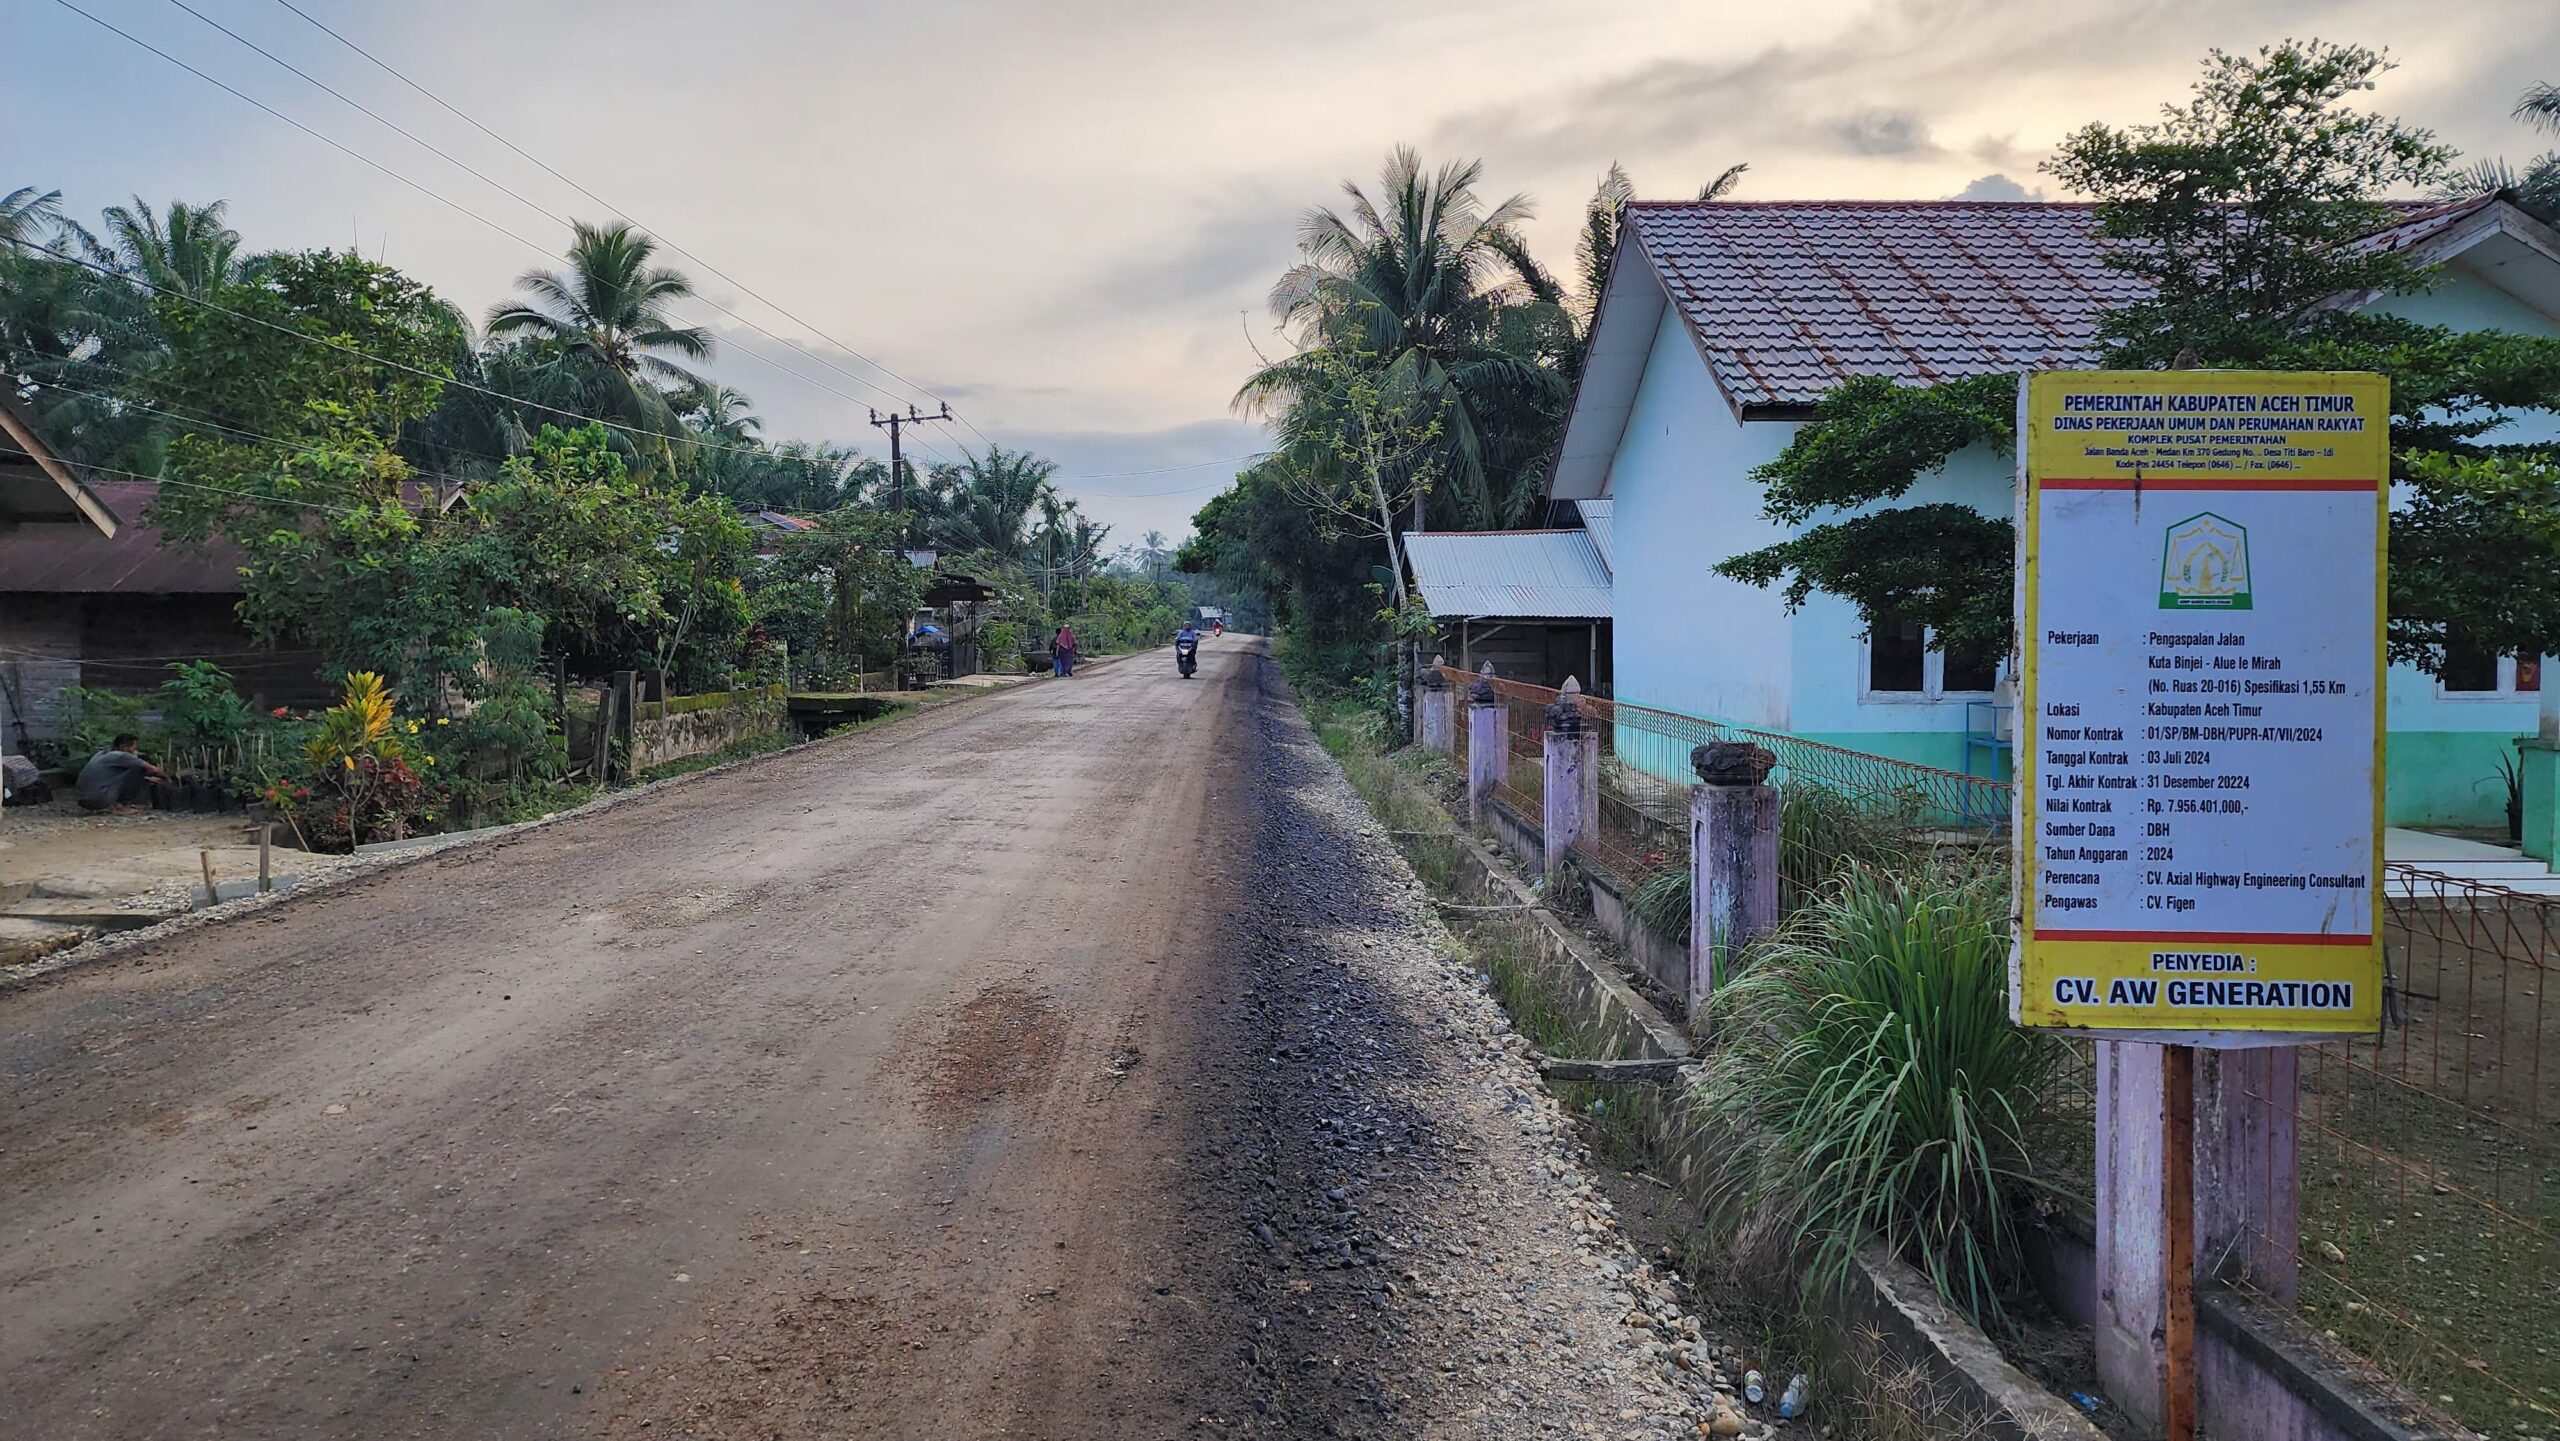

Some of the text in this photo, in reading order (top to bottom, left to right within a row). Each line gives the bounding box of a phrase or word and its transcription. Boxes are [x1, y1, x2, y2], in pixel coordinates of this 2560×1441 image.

[2065, 396, 2354, 412] PEMERINTAH KABUPATEN ACEH TIMUR
[2055, 417, 2365, 431] DINAS PEKERJAAN UMUM DAN PERUMAHAN RAKYAT
[2128, 435, 2286, 444] KOMPLEK PUSAT PEMERINTAHAN
[2085, 448, 2104, 456] Jalan
[2107, 448, 2128, 456] Banda
[2131, 448, 2148, 456] Aceh
[2156, 448, 2180, 456] Medan
[2183, 448, 2194, 456] Km
[2197, 448, 2210, 456] 370
[2213, 448, 2240, 458] Gedung
[2243, 449, 2254, 457] No.
[2178, 461, 2206, 470] Telepon
[2048, 631, 2099, 647] Pekerjaan
[2150, 632, 2214, 648] Pengaspalan
[2217, 633, 2245, 646] Jalan
[2149, 656, 2171, 668] Kuta
[2175, 656, 2203, 672] Binjei
[2213, 657, 2235, 669] Alue
[2252, 657, 2281, 669] Mirah
[2149, 679, 2345, 696] (No. Ruas 20-016) Spesifikasi 1,55 Km
[2047, 703, 2080, 716] Lokasi
[2148, 703, 2201, 718] Kabupaten
[2204, 703, 2229, 716] Aceh
[2233, 703, 2262, 717] Timur
[2047, 727, 2081, 740] Nomor
[2084, 727, 2123, 740] Kontrak
[2148, 727, 2322, 742] 01/SP/BM-DBH/PUPR-AT/VII/2024
[2047, 751, 2085, 767] Tanggal
[2089, 751, 2128, 764] Kontrak
[2148, 751, 2160, 764] 03
[2163, 751, 2181, 764] Juli
[2185, 751, 2210, 764] 2024
[2046, 775, 2064, 791] Tgl.
[2068, 775, 2094, 788] Akhir
[2098, 775, 2137, 788] Kontrak
[2147, 775, 2159, 788] 31
[2164, 775, 2214, 788] Desember
[2218, 776, 2250, 789] 20224
[2046, 799, 2069, 812] Nilai
[2073, 799, 2112, 812] Kontrak
[2147, 799, 2164, 815] Rp.
[2046, 823, 2085, 836] Sumber
[2089, 823, 2115, 836] Dana
[2147, 823, 2170, 836] DBH
[2045, 847, 2075, 860] Tahun
[2079, 847, 2128, 863] Anggaran
[2147, 847, 2173, 861] 2024
[2045, 870, 2100, 884] Perencana
[2147, 871, 2163, 884] CV.
[2166, 872, 2192, 885] Axial
[2196, 872, 2240, 888] Highway
[2244, 873, 2305, 890] Engineering
[2309, 874, 2365, 888] Consultant
[2045, 895, 2098, 911] Pengawas
[2147, 895, 2163, 909] CV.
[2167, 896, 2195, 912] Figen
[2153, 954, 2244, 971] PENYEDIA
[2056, 979, 2351, 1008] CV. AW GENERATION
